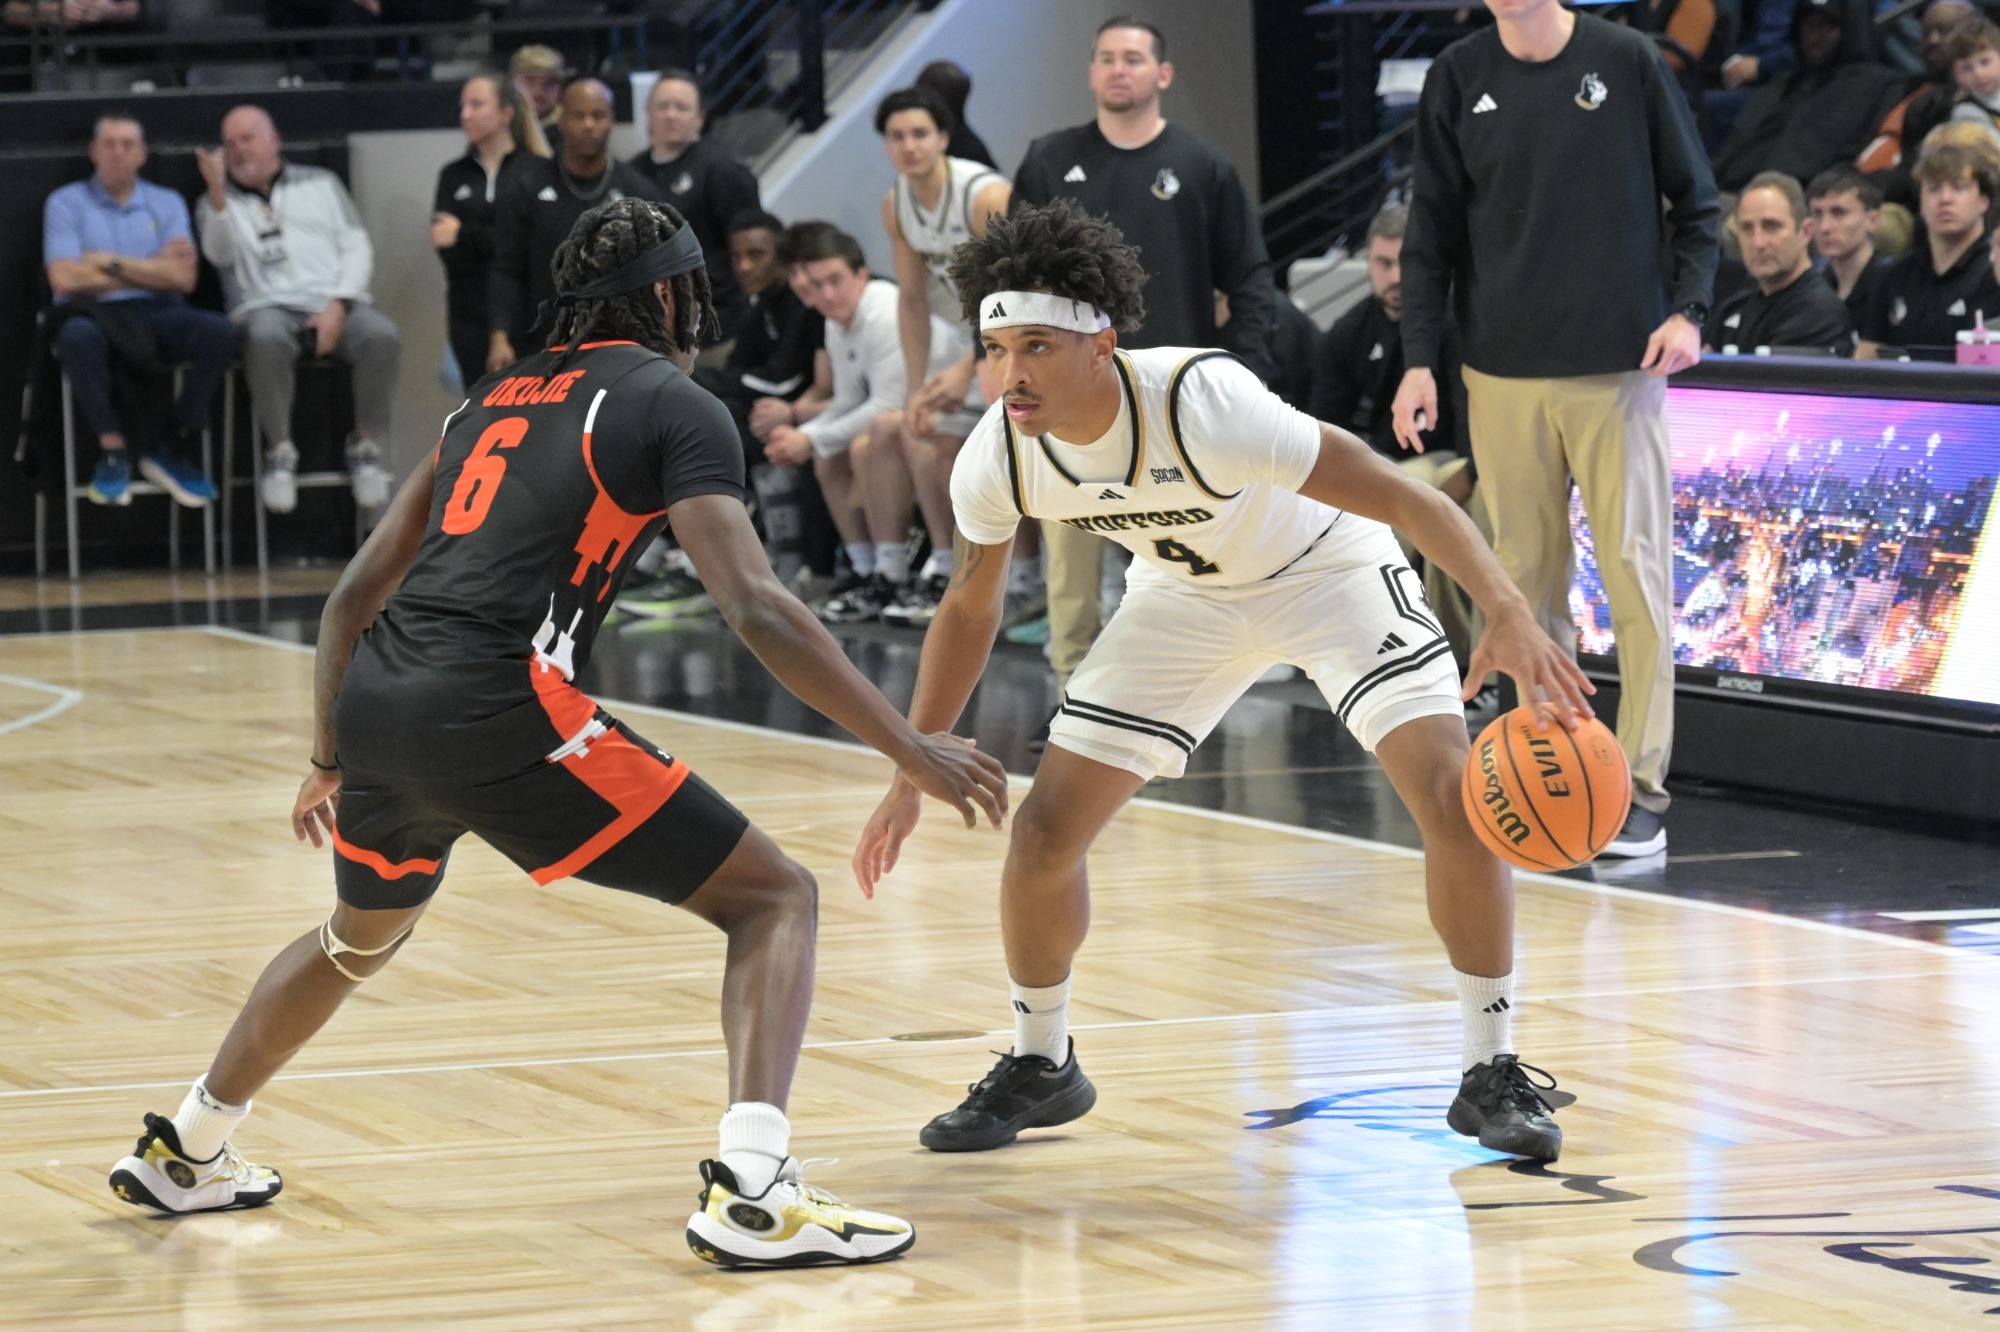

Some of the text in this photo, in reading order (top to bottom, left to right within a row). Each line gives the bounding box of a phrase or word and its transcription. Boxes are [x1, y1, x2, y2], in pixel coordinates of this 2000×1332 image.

[482, 369, 587, 407] OKOJIE
[441, 416, 530, 535] 6
[1058, 507, 1215, 532] WOFFORD
[1150, 536, 1223, 576] 4
[1480, 736, 1531, 847] Wilson
